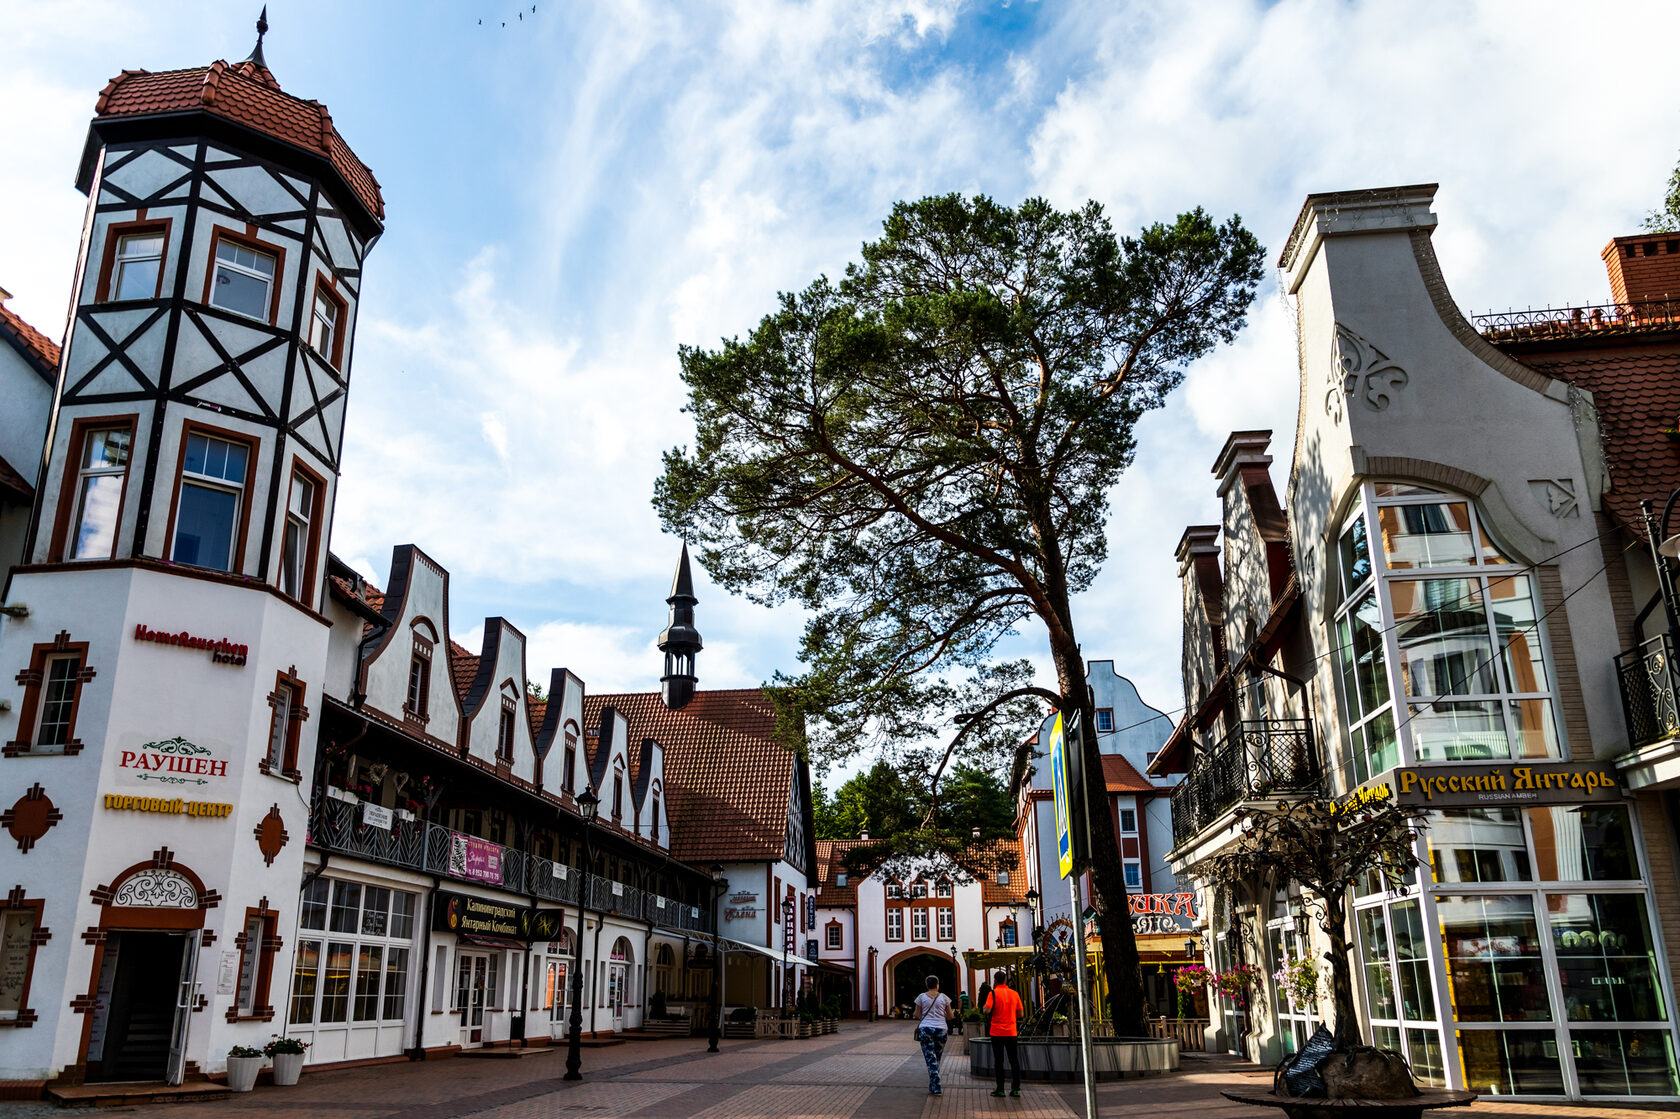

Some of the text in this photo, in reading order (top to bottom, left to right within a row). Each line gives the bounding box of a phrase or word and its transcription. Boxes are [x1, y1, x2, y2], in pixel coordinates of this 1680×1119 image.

[135, 624, 249, 656] HomeRauschen
[212, 651, 247, 666] hotel
[119, 751, 228, 776] РАУШЕН
[1400, 767, 1615, 799] Русский Янтарь
[104, 793, 234, 818] ТОРГОВЫЙ ЦЕНТР
[467, 898, 516, 919] Калининградский
[461, 916, 491, 932] Янтарный
[492, 920, 517, 935] Комбинат
